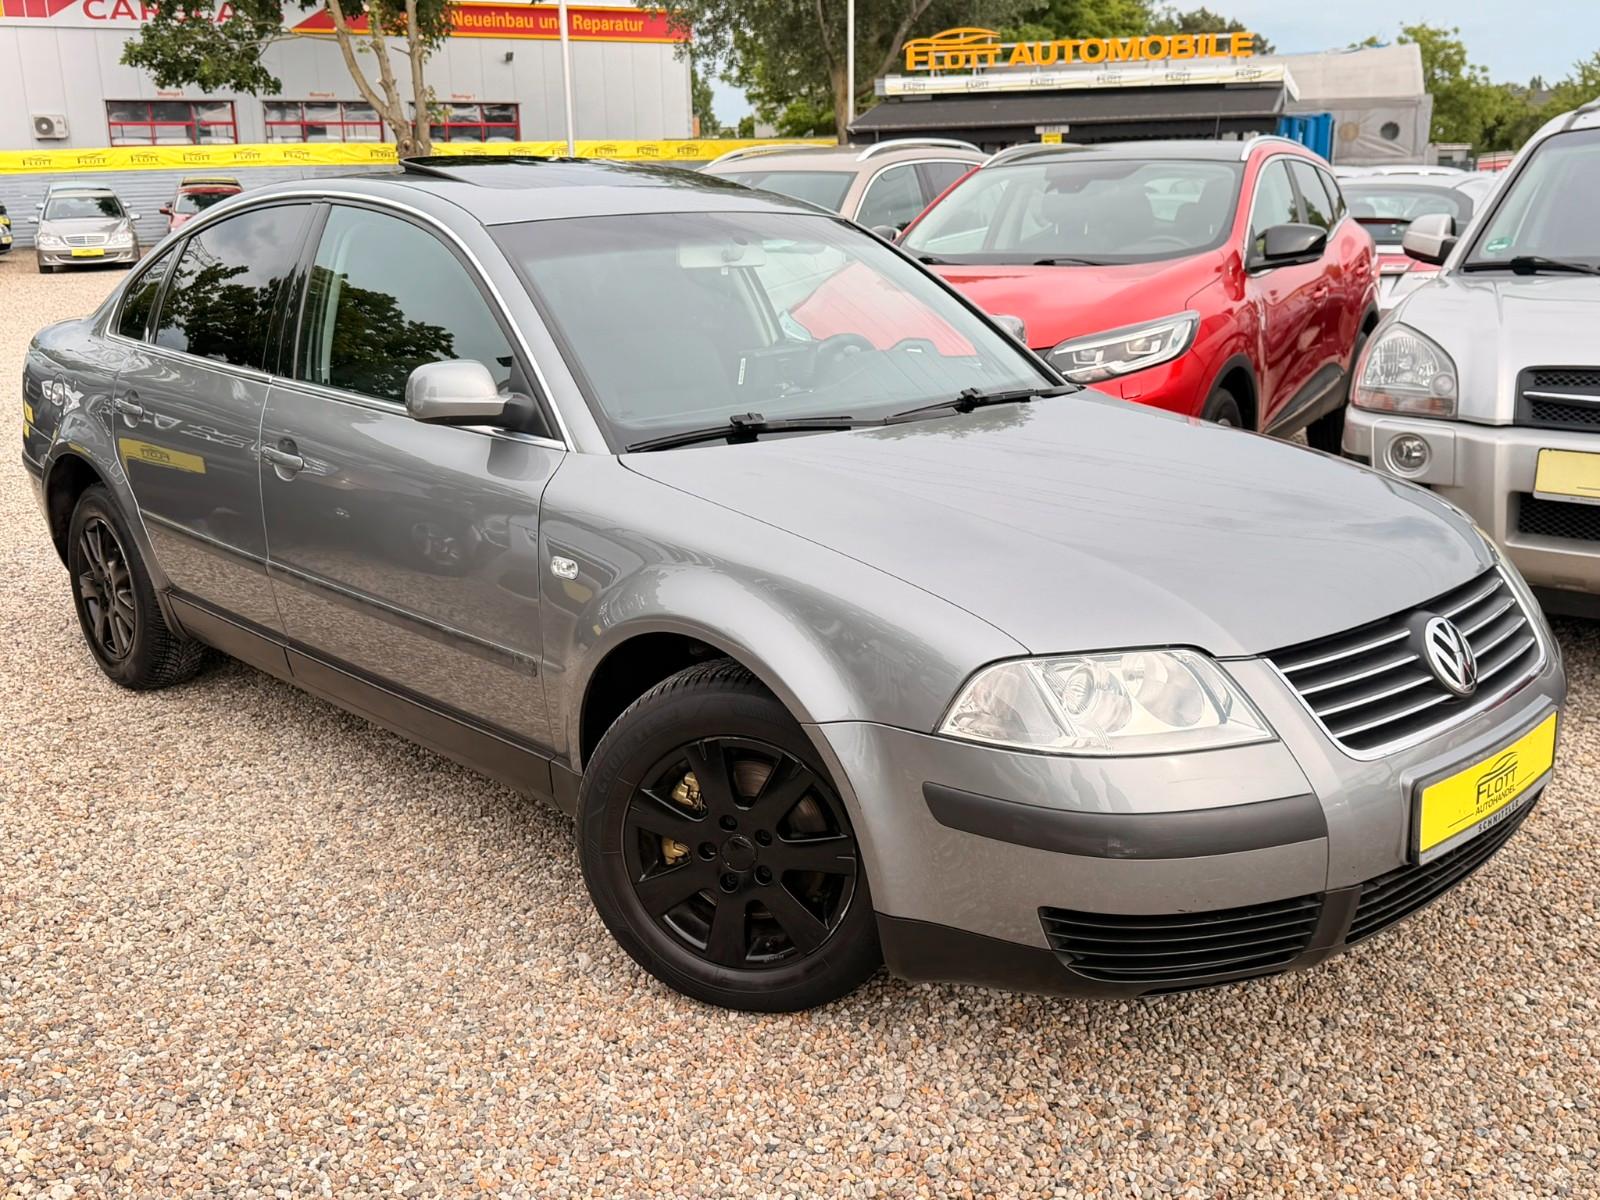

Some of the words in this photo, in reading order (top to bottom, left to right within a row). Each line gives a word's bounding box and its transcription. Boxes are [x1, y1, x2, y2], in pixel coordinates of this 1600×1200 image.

[452, 11, 532, 29] Neueinbau
[539, 17, 562, 30] un
[573, 14, 644, 33] Reparatur
[1008, 31, 1255, 66] AUTOMOBILE
[1476, 761, 1518, 805] FLOTT
[1475, 784, 1516, 816] AUTOHANDEL
